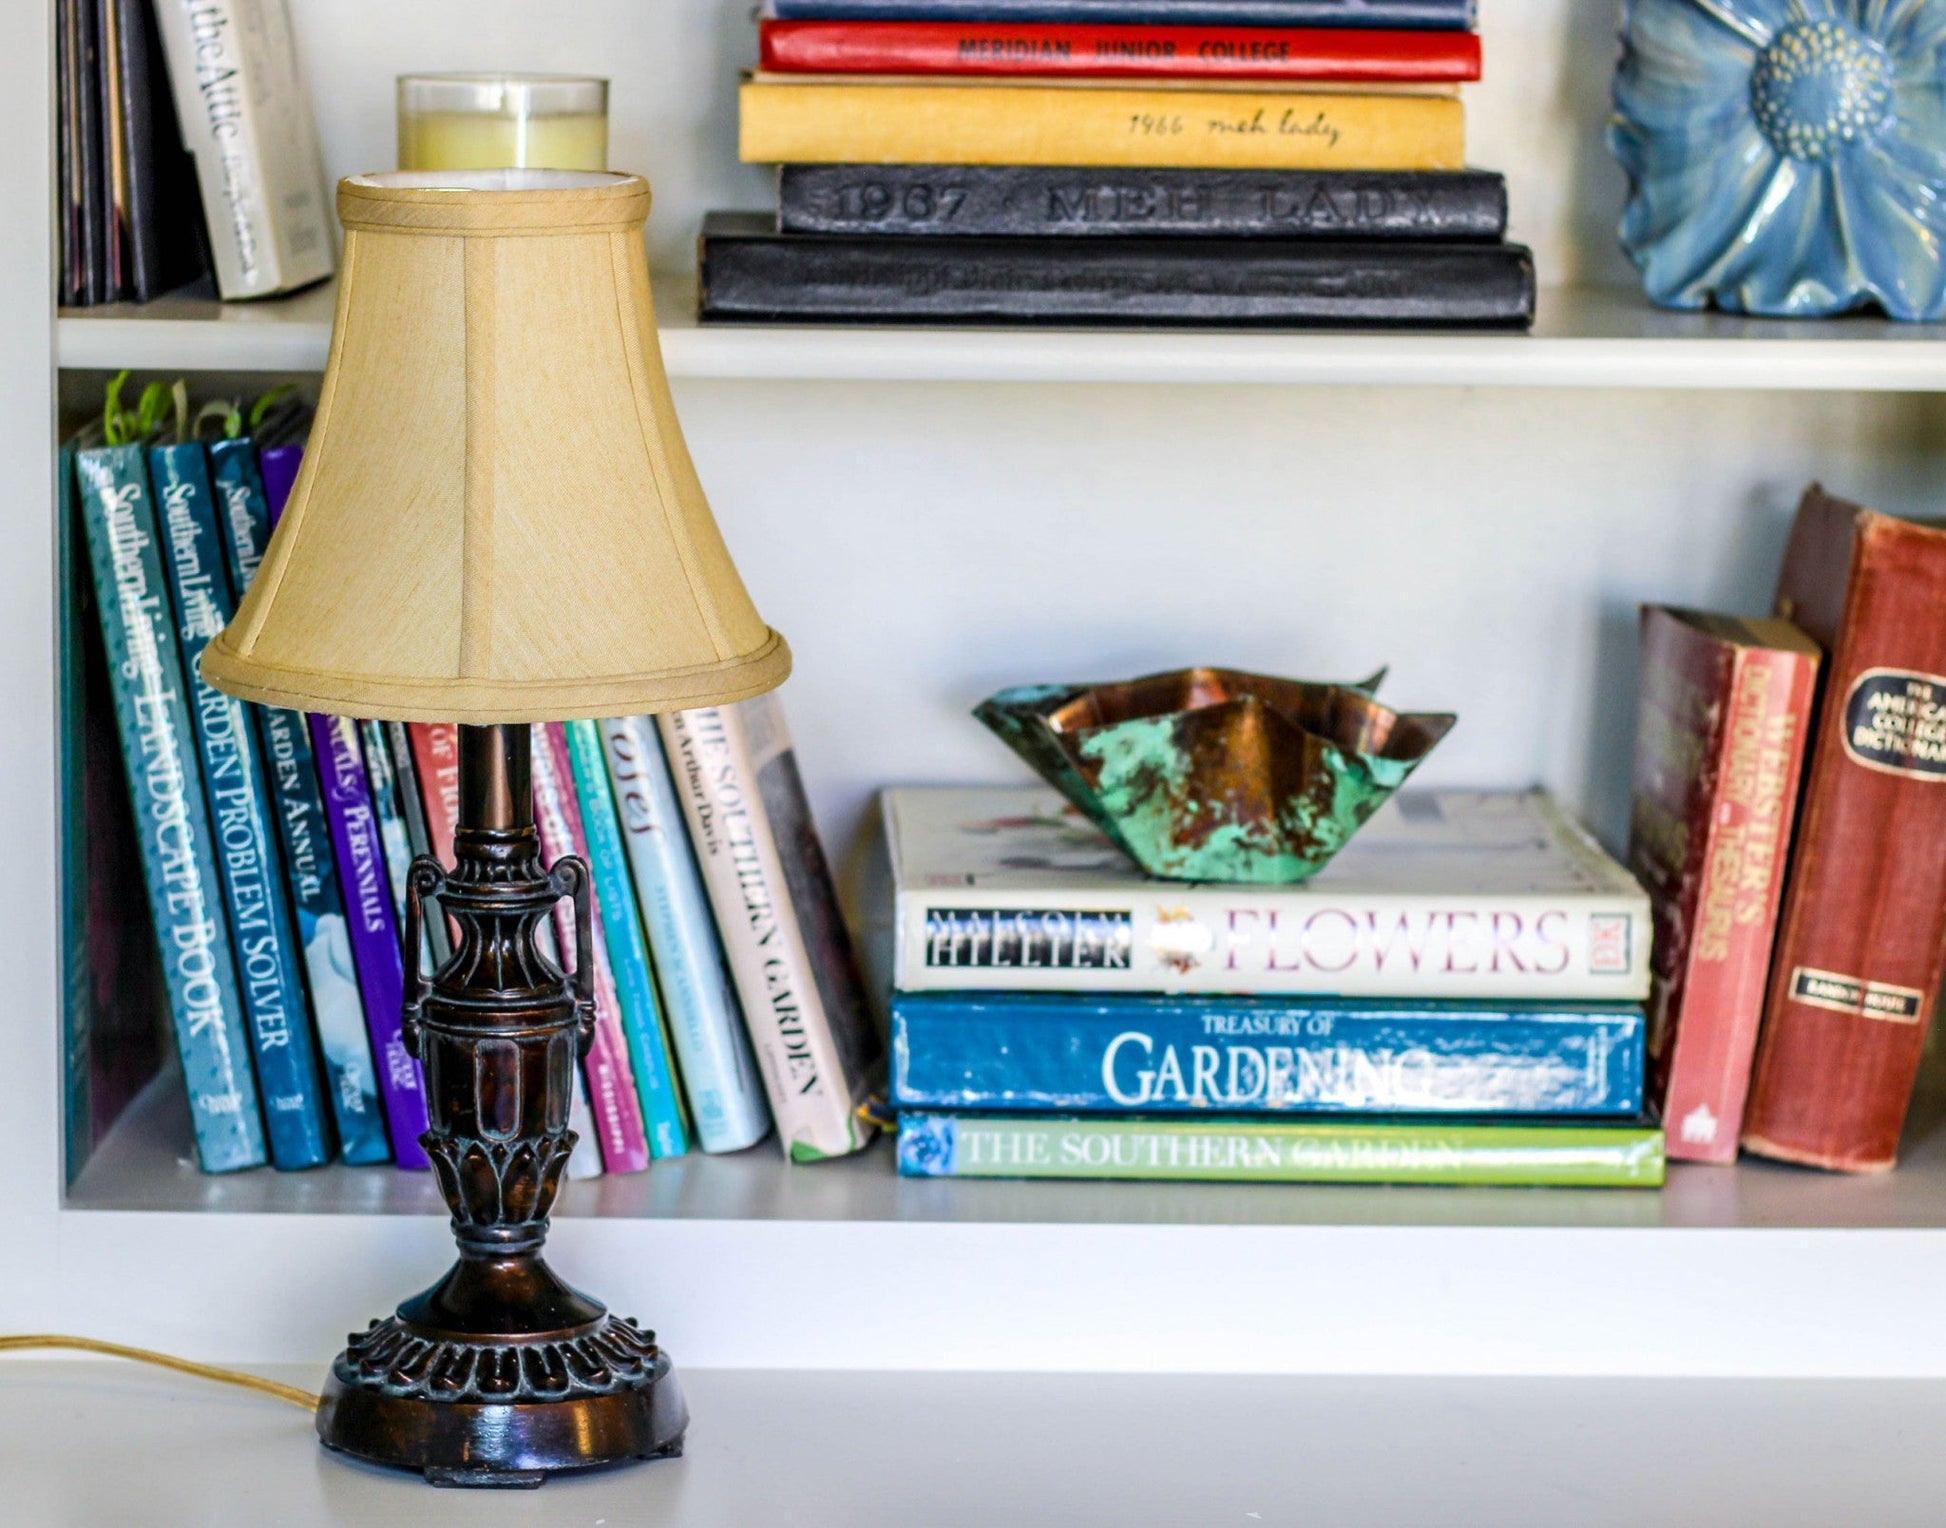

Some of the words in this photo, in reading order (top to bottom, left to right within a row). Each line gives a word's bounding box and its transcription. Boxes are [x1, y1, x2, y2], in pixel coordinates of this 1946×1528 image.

[957, 38, 1072, 61] MERIDIAN
[1093, 39, 1176, 61] JUNIOR
[1197, 40, 1291, 62] COLLEGE
[196, 64, 241, 140] Attic
[1128, 112, 1185, 135] 1966
[833, 182, 971, 222] 1967
[1258, 182, 1442, 223] LADY
[163, 483, 202, 579] Southern
[178, 573, 212, 641] Living
[267, 706, 300, 790] ARDEN
[284, 797, 320, 903] ANNUAL
[679, 733, 705, 799] Arthur
[698, 803, 722, 857] Davis
[1734, 712, 1797, 926] WEBSTER'S
[133, 687, 206, 915] LANDSCAPE
[172, 917, 226, 1037] BOOK
[214, 785, 268, 931] PROBLEM
[343, 804, 386, 933] PERENNIALS
[696, 706, 729, 757] HE
[715, 763, 781, 947] SOUTHERN
[764, 958, 825, 1096] GARDEN
[930, 936, 1127, 968] HILLIER
[1222, 908, 1571, 974] FLOWERS
[242, 935, 289, 1053] SOLVER
[1201, 1015, 1303, 1036] TREASURY
[1306, 1015, 1336, 1036] OF
[1101, 1031, 1433, 1106] GARDENING
[961, 1132, 1050, 1165] THE
[1059, 1133, 1283, 1169] SOUTHERN
